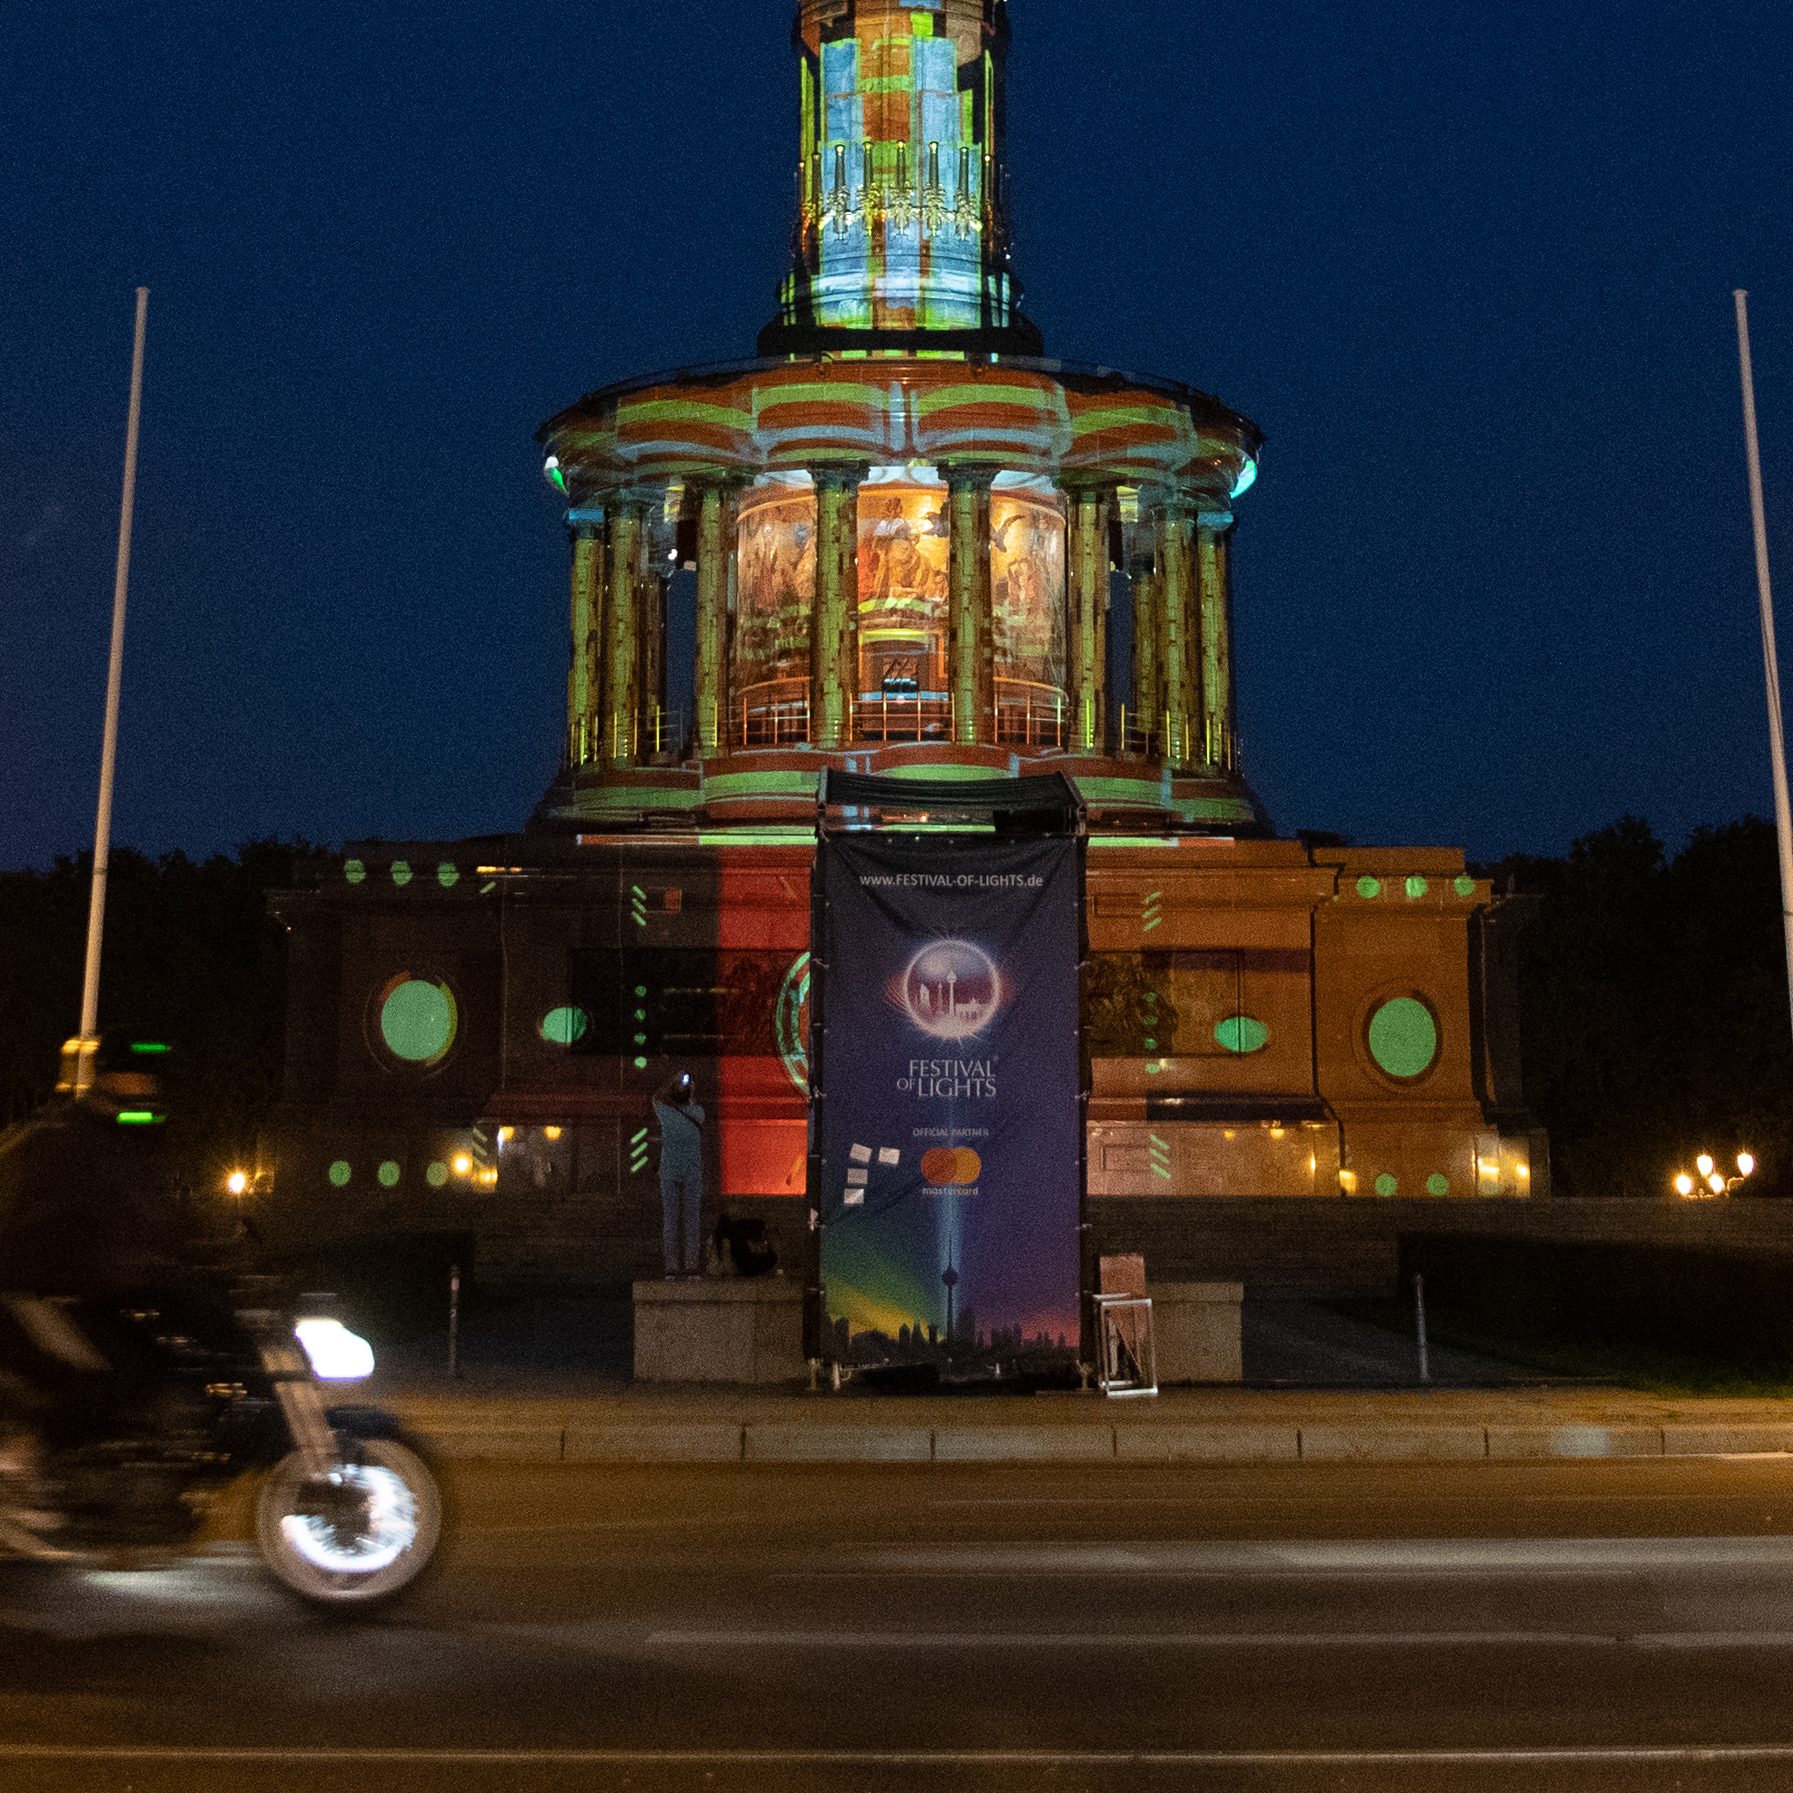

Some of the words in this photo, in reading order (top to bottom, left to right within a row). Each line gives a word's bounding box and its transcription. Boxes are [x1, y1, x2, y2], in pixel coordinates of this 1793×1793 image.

[859, 874, 1043, 887] www.FESTIVAL-OF-LIGHTS.de
[909, 1059, 997, 1077] FESTIVAL
[896, 1077, 916, 1090] OF
[918, 1077, 997, 1097] LIGHTS
